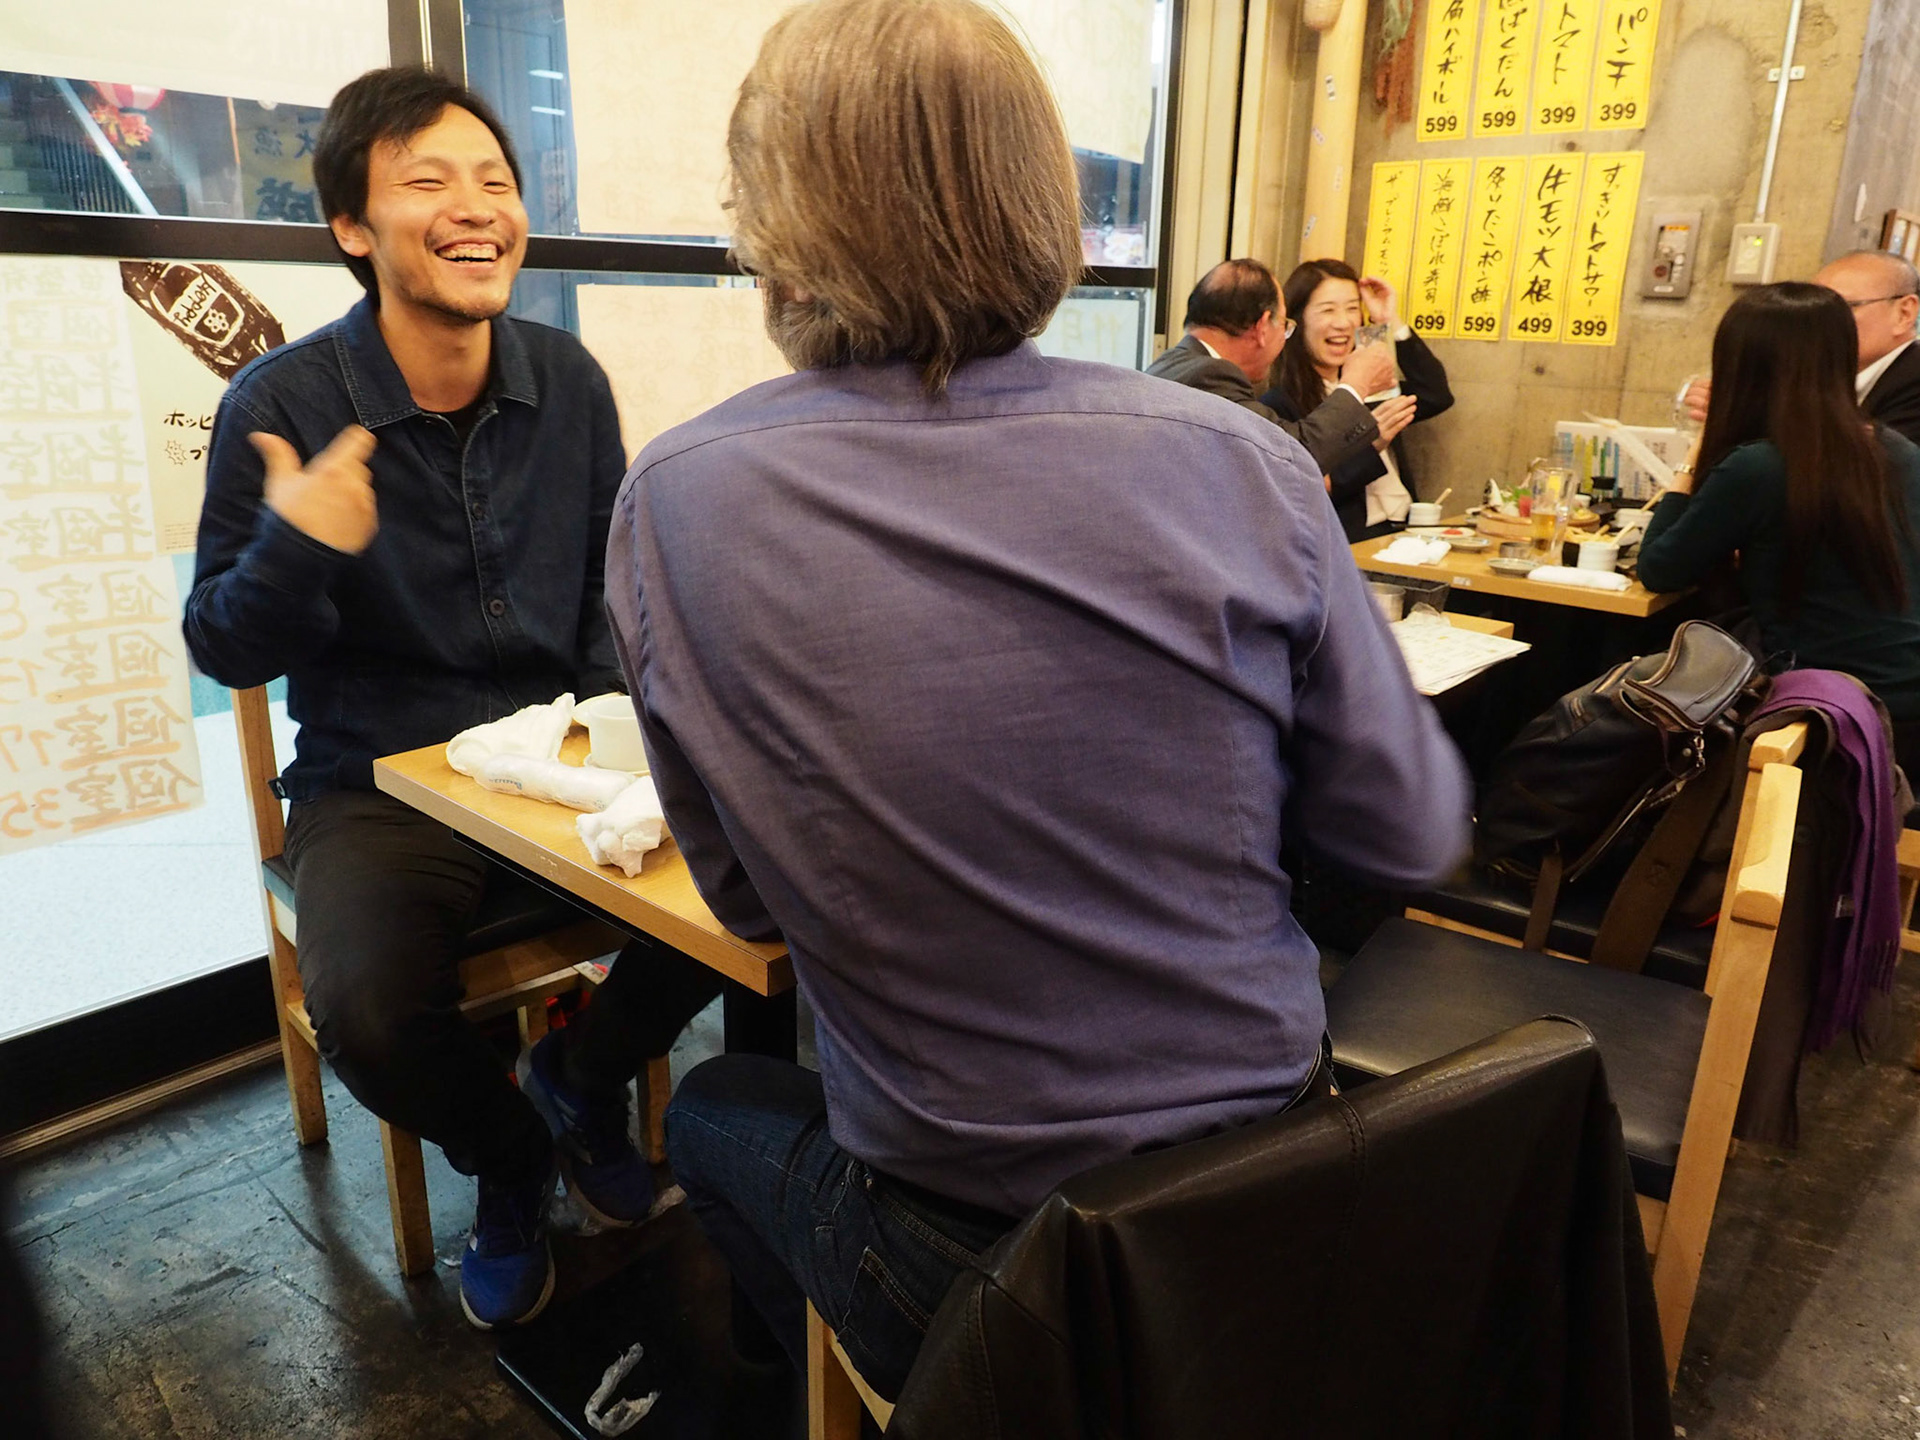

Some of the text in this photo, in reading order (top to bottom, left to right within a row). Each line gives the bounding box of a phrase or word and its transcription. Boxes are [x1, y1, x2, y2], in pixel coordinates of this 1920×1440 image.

[1606, 8, 1648, 88] パンチ
[1482, 110, 1516, 129] 599
[1540, 106, 1576, 124] 399
[1600, 102, 1637, 121] 399
[1425, 115, 1458, 133] 599
[1520, 163, 1572, 306] 牛モツ大根
[1413, 315, 1446, 331] 699
[1463, 316, 1497, 332] 599
[1517, 317, 1553, 334] 499
[1571, 320, 1608, 337] 399
